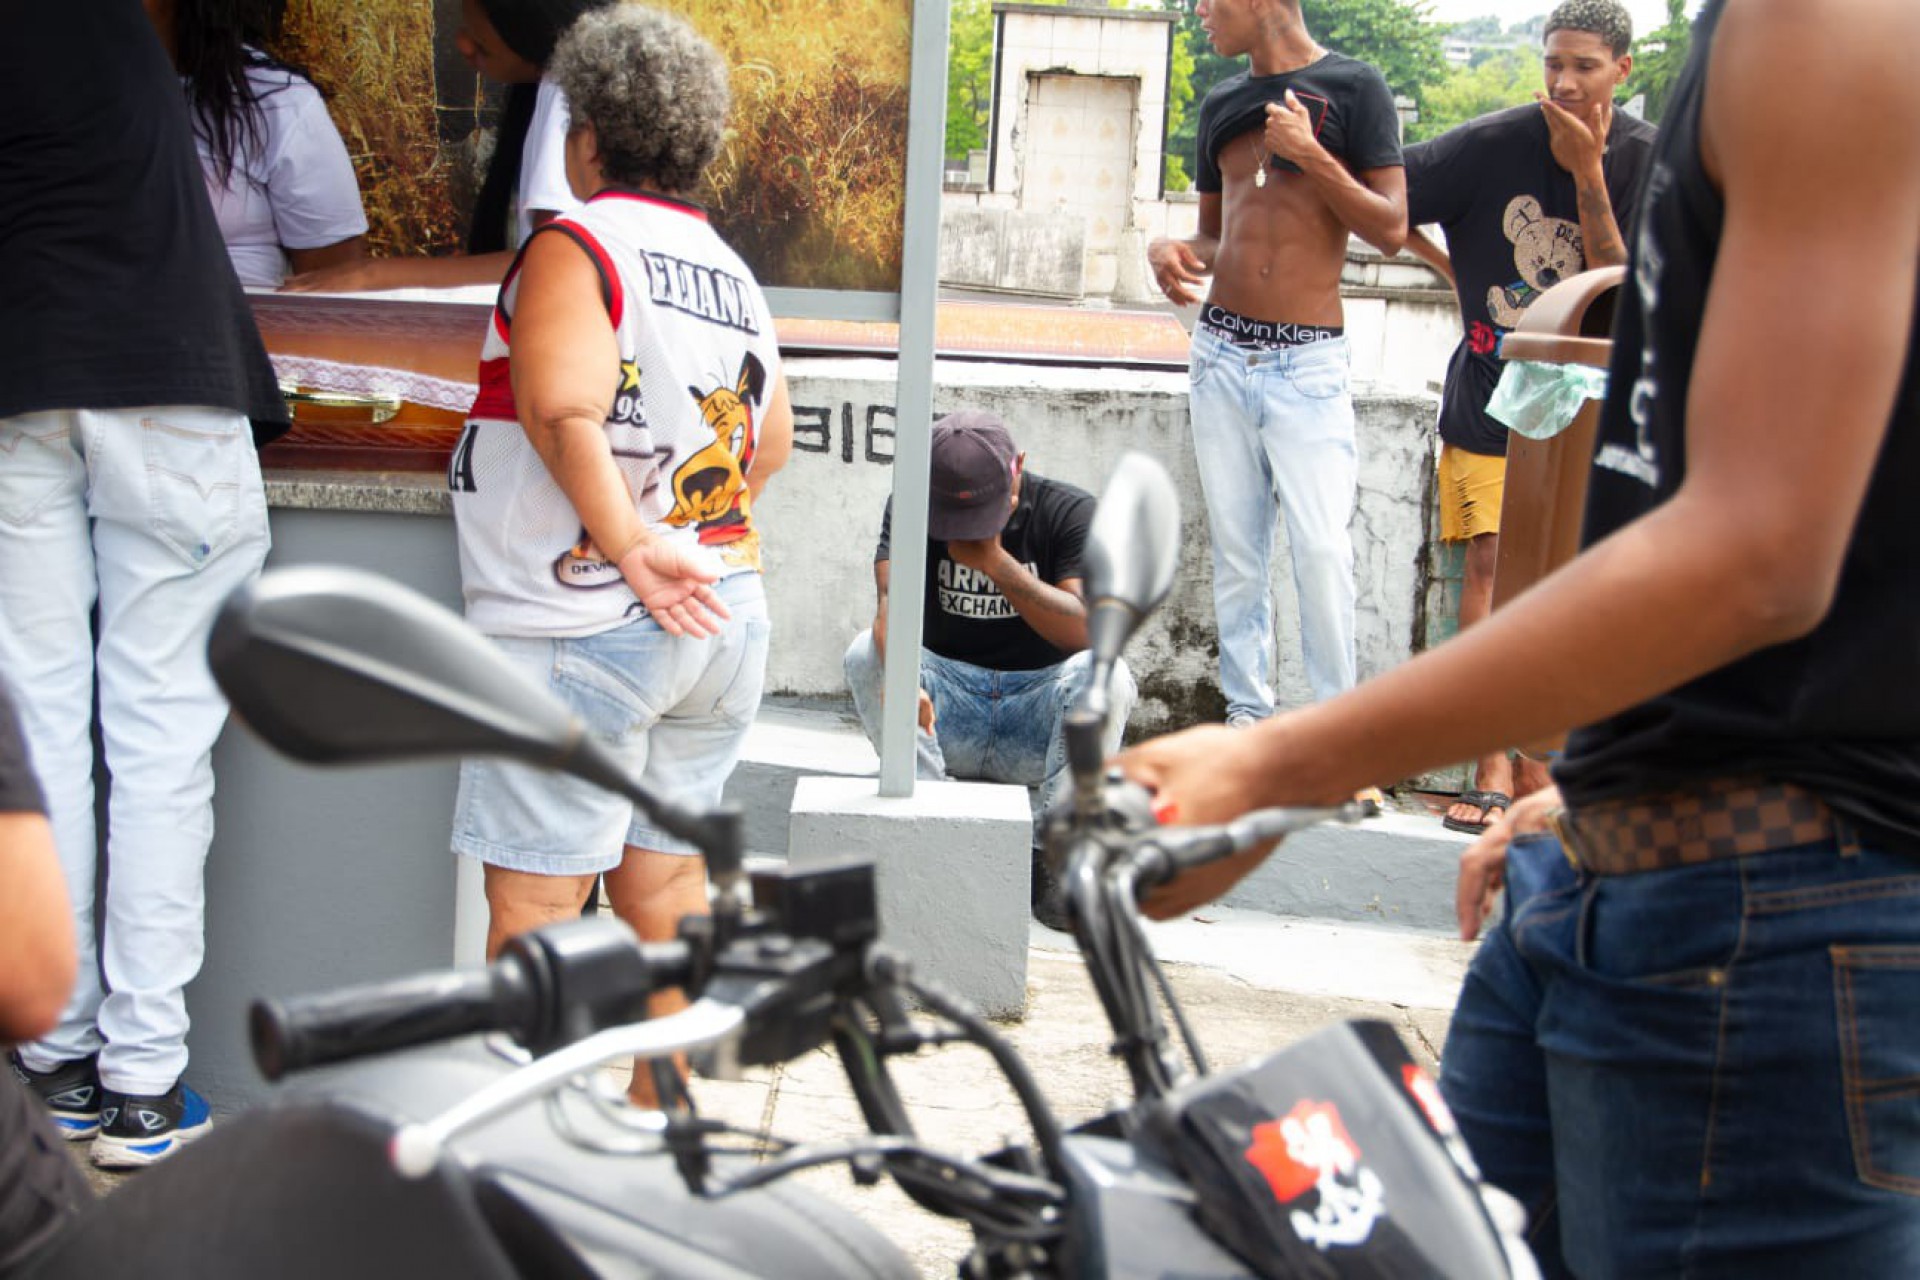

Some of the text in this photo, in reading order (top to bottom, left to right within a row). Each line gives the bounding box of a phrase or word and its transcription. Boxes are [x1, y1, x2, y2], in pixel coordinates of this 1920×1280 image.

[639, 248, 759, 336] ELIANA
[1208, 306, 1272, 339] Calvin
[1276, 322, 1332, 343] Klein
[940, 592, 1018, 617] EXCHAN
